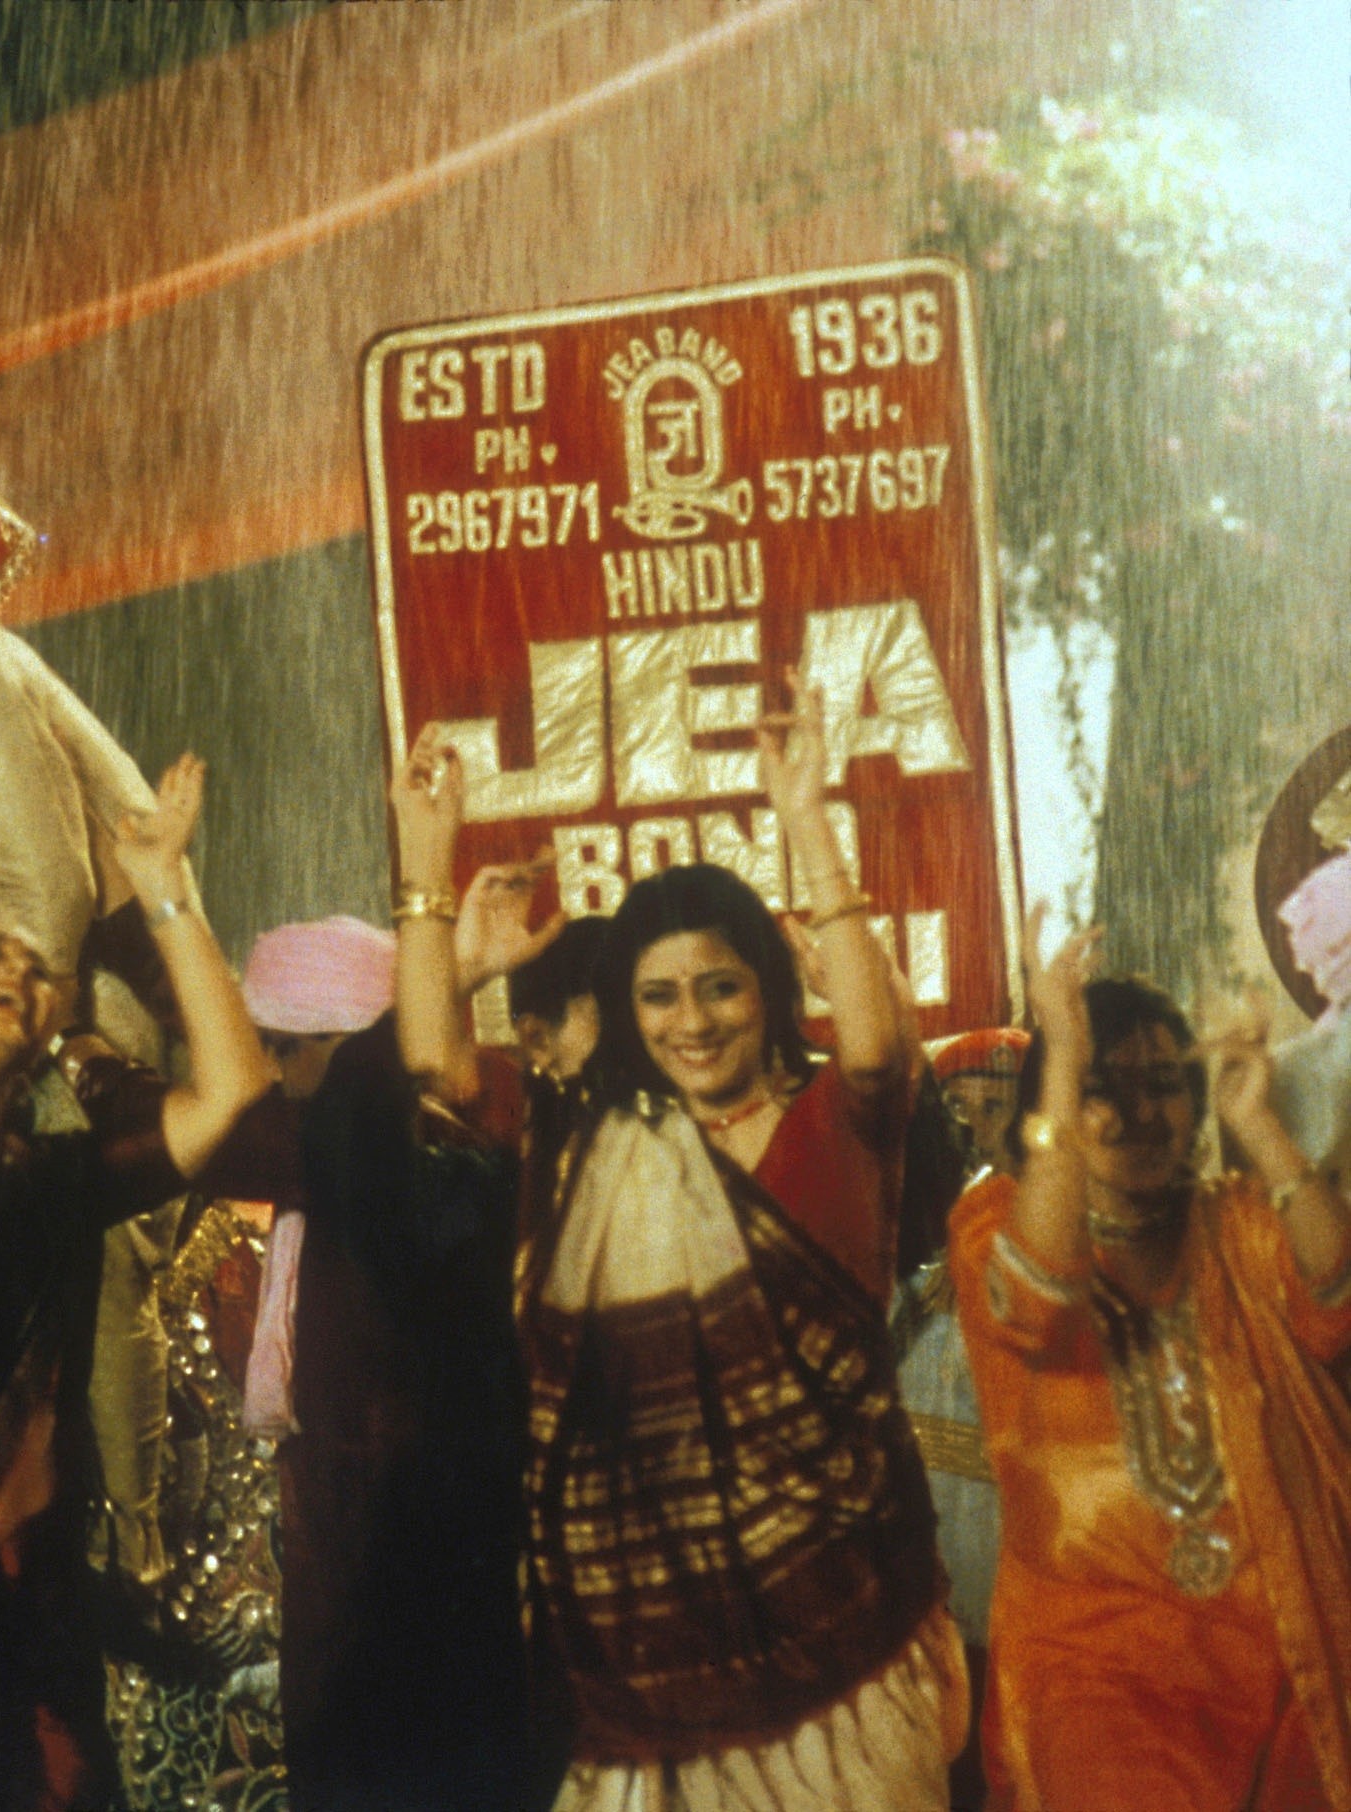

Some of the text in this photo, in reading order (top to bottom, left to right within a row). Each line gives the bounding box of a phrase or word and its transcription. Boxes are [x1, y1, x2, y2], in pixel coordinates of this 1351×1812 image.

[603, 337, 656, 400] JEA
[789, 290, 943, 378] 1936
[402, 343, 547, 422] ESTD
[407, 481, 600, 555] 2967971
[764, 445, 951, 522] 5737697
[602, 539, 765, 618] HINDU
[438, 599, 972, 824] JEA
